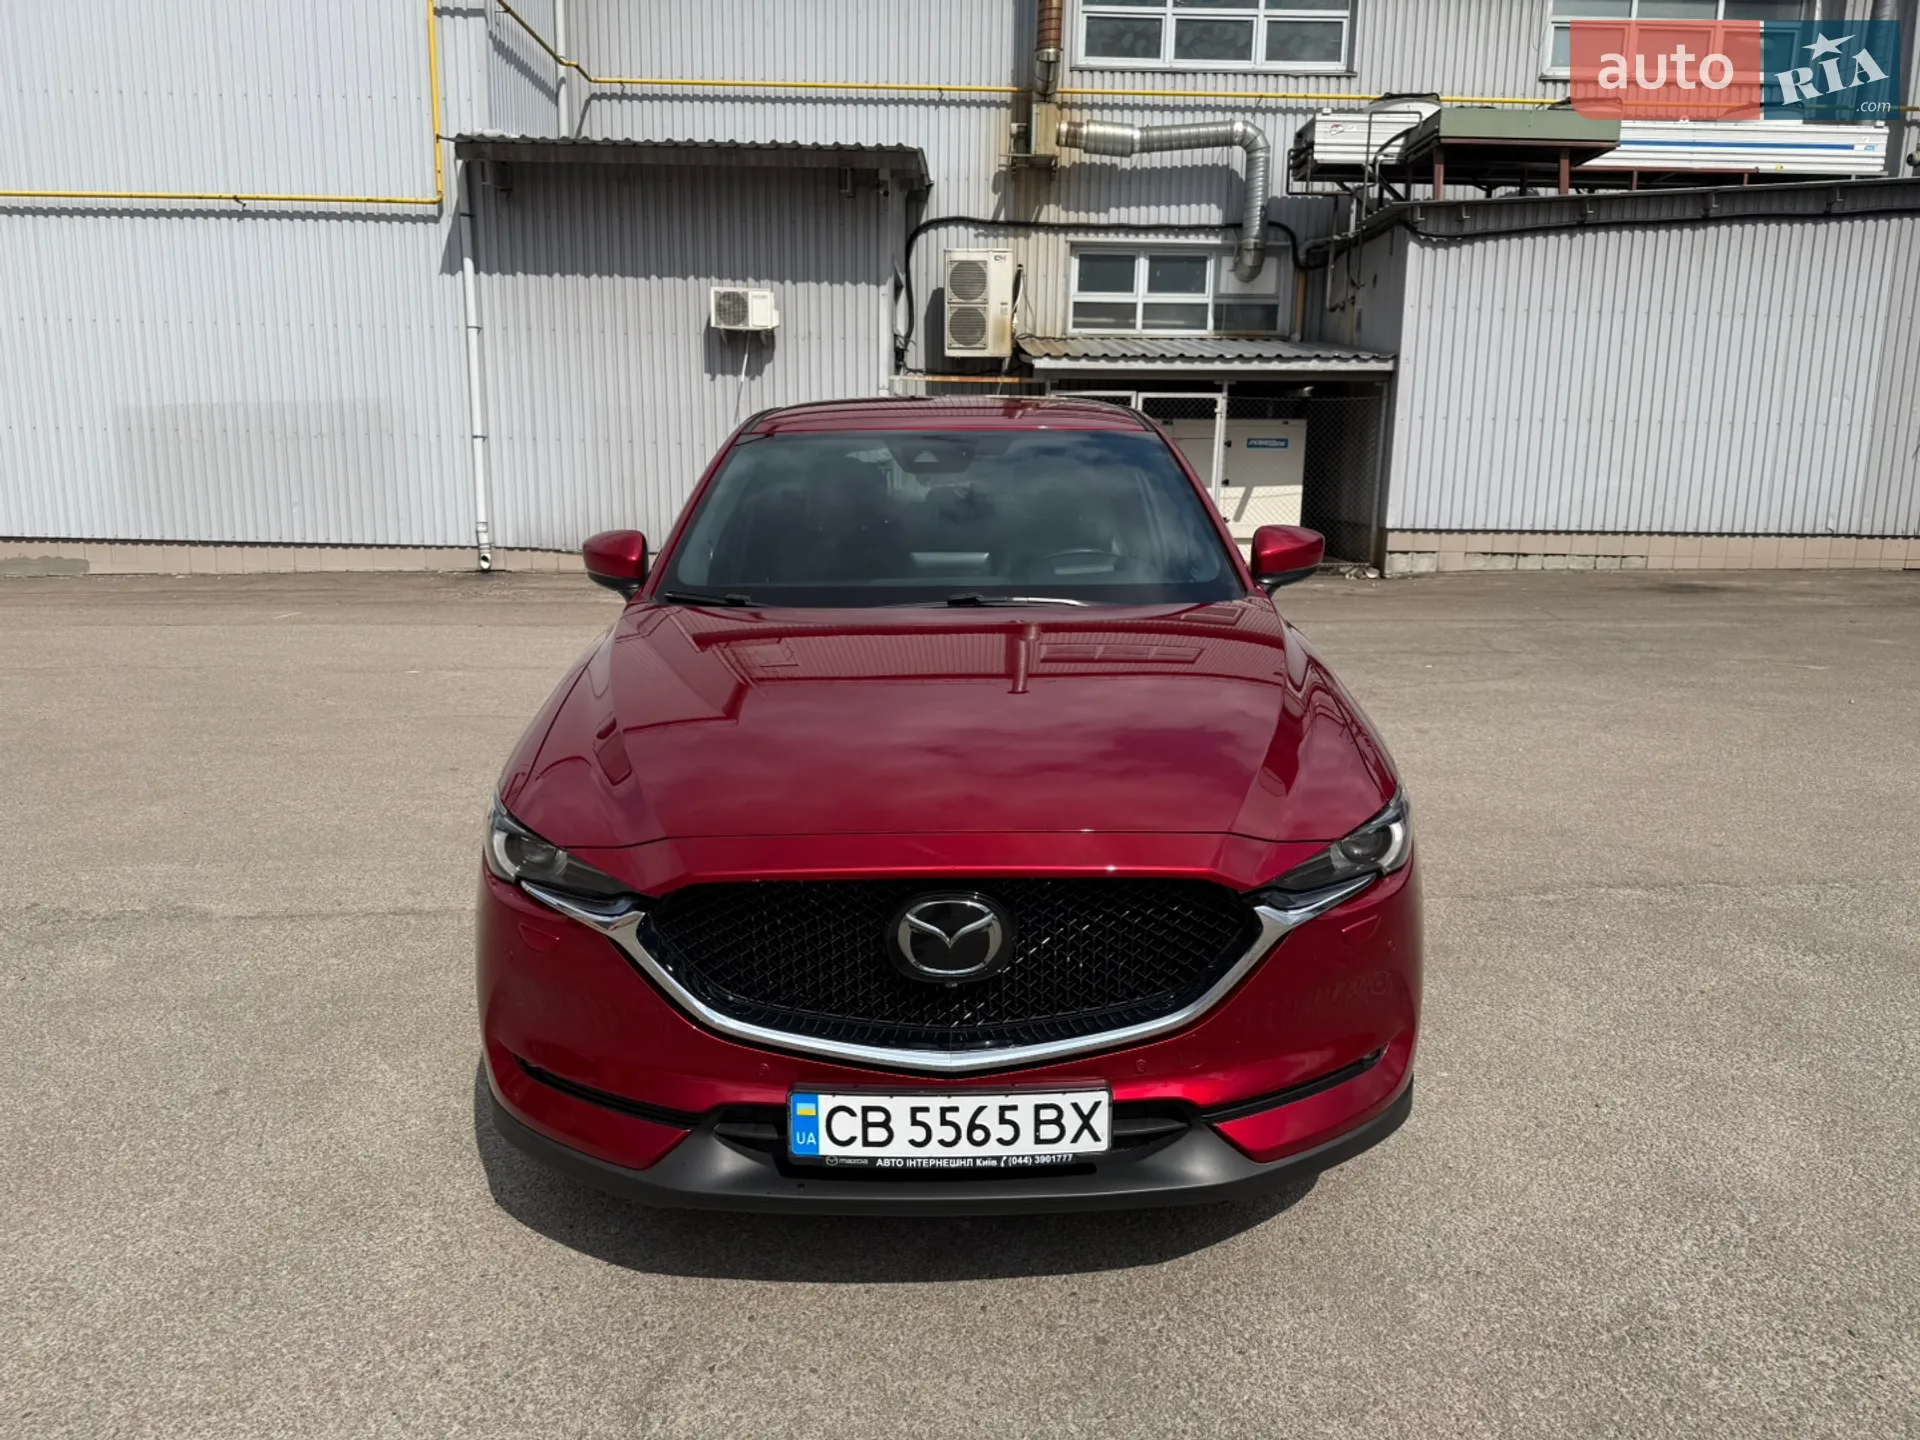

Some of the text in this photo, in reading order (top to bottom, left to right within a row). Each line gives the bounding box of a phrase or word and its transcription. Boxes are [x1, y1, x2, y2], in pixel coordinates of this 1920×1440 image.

[825, 1100, 1103, 1148] CB 5565 BX
[796, 1131, 816, 1145] UA
[876, 1154, 1073, 1168] АВТО ІНТЕРНЕШНЛ Київ (044) 3901777
